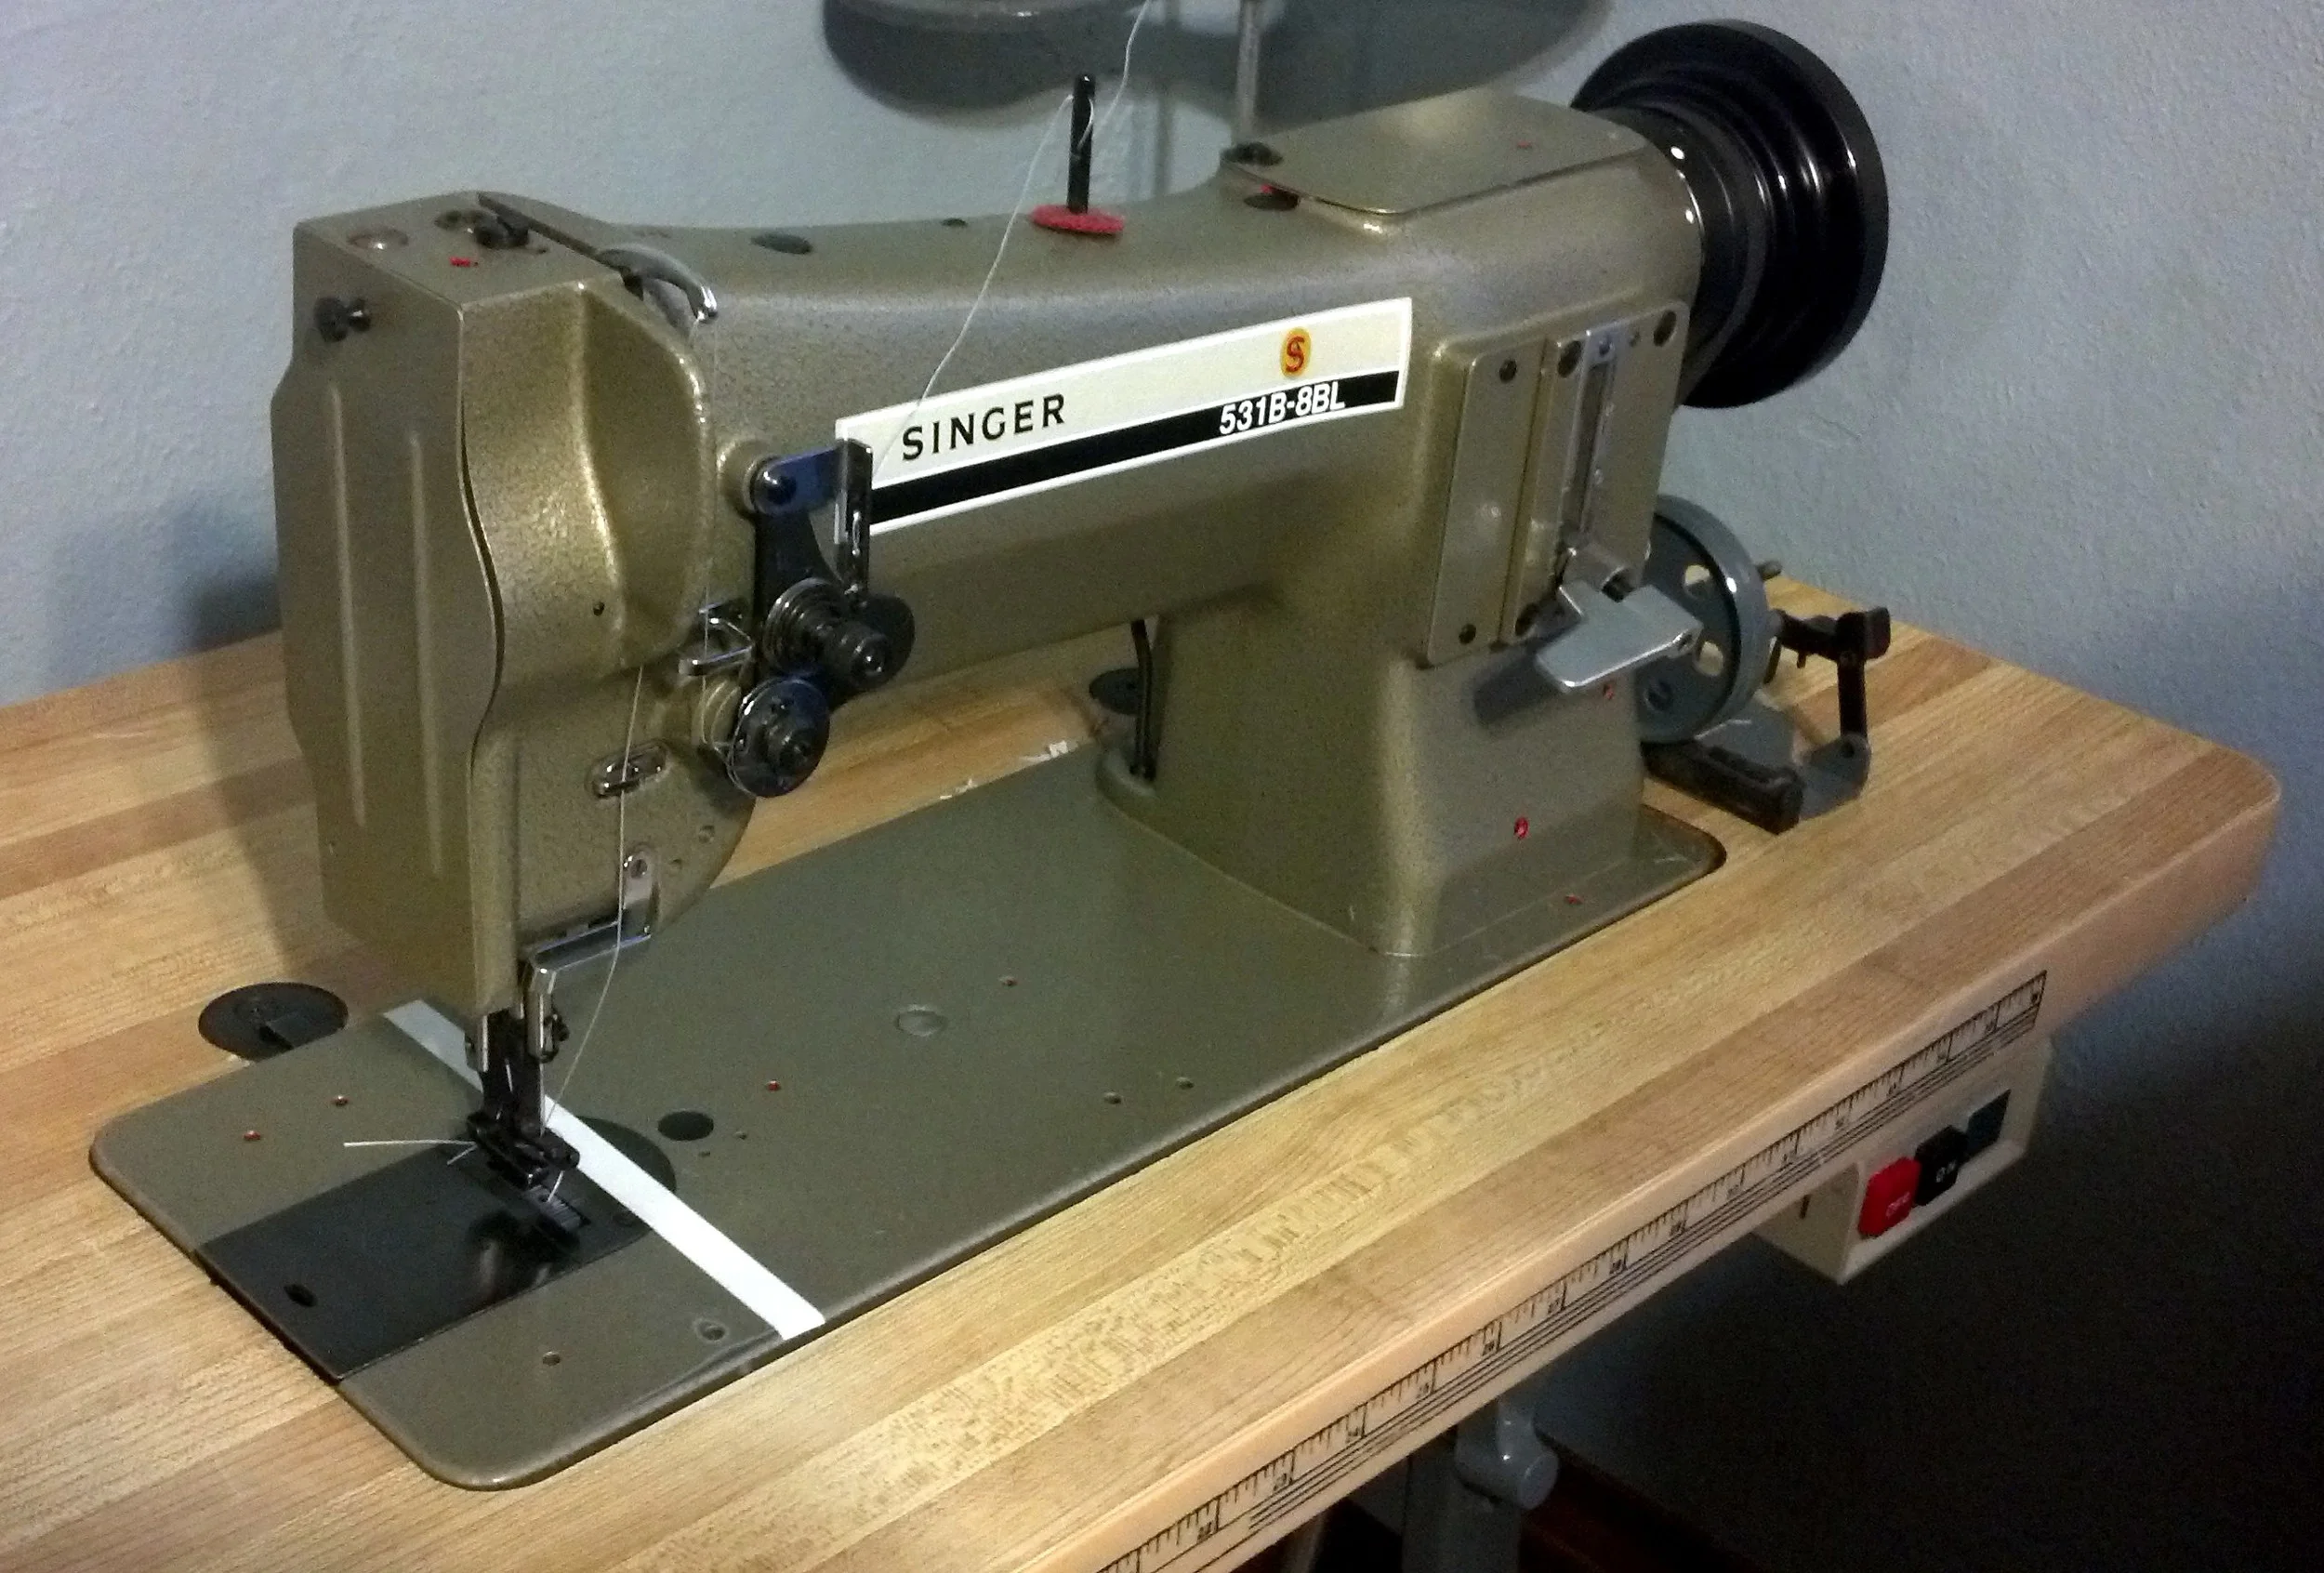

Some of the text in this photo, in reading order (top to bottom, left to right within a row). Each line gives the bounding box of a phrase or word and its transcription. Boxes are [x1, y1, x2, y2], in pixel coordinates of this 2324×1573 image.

[1285, 335, 1305, 373] S
[902, 392, 1065, 461] SINGER
[1219, 380, 1346, 435] 531B-8BL
